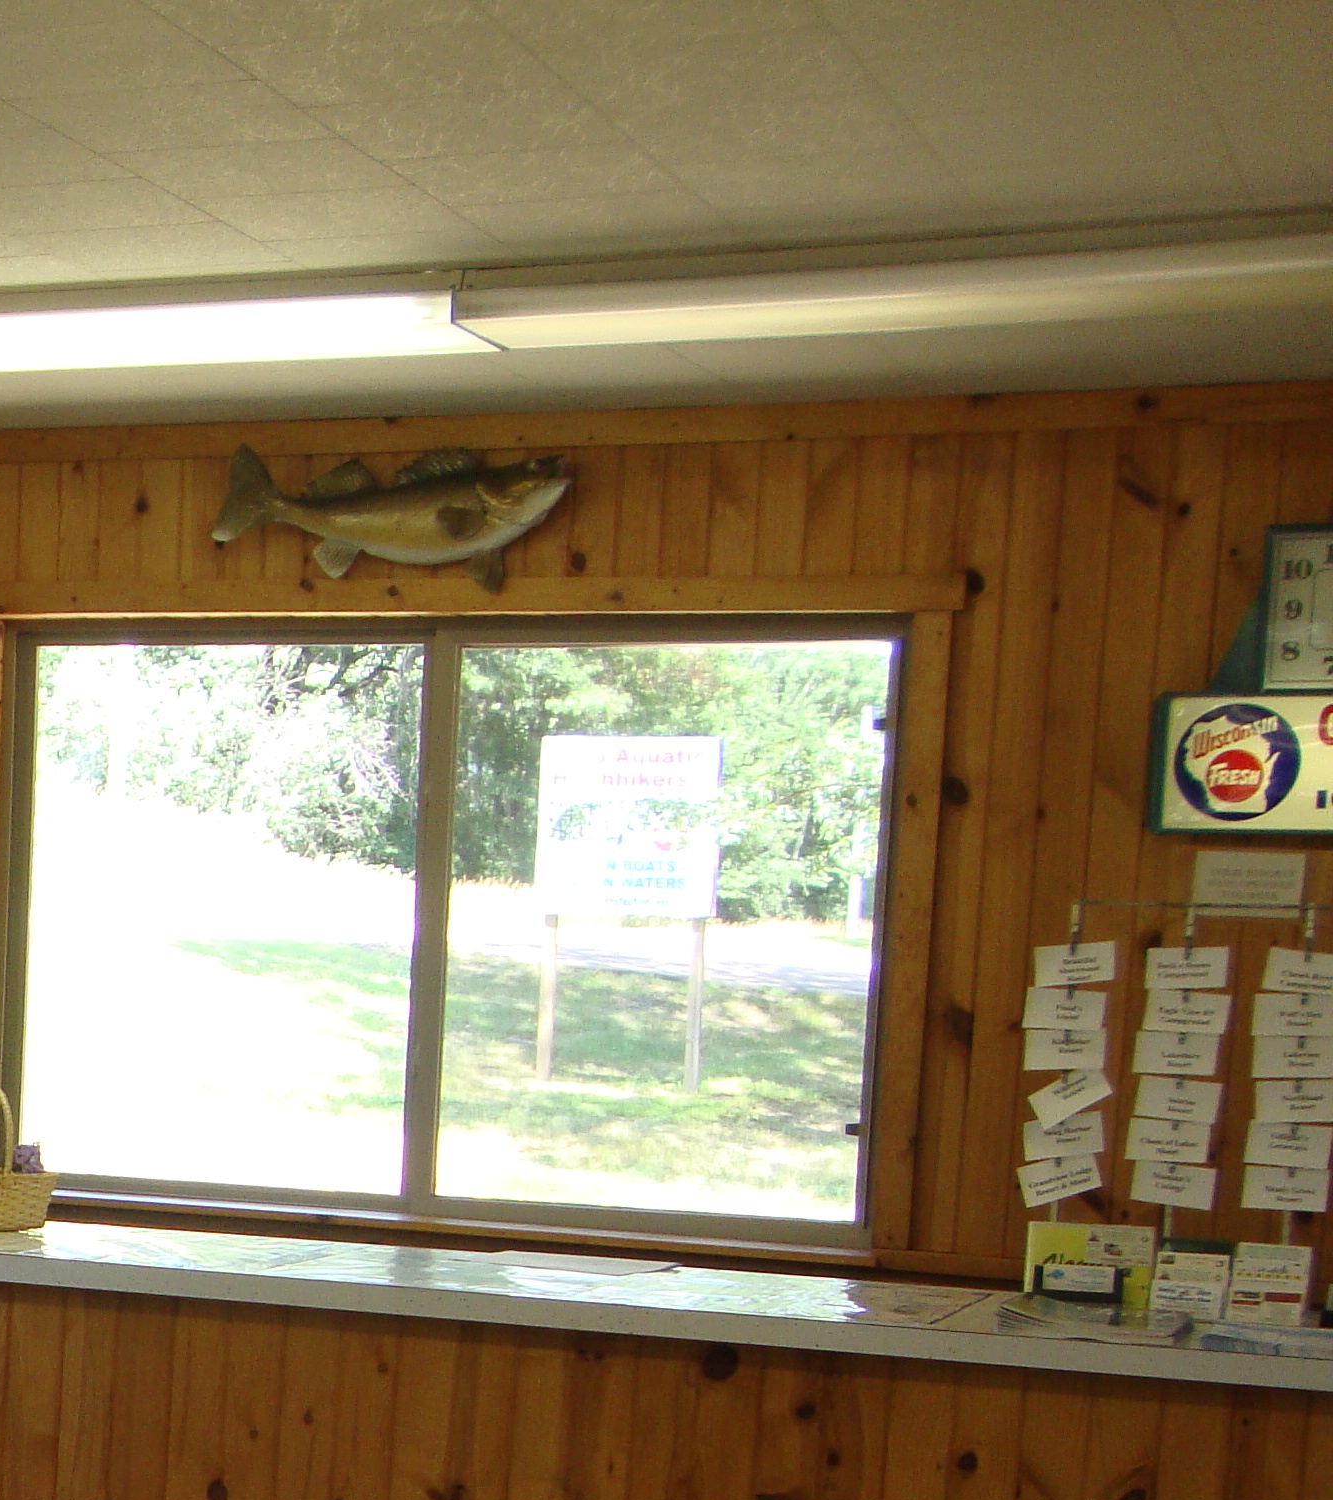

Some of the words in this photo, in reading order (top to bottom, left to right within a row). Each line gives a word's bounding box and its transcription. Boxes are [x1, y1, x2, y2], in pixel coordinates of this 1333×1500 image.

[1283, 559, 1313, 580] 10
[1192, 716, 1278, 759] Wisconsin
[1207, 762, 1261, 787] FRESH
[623, 860, 676, 873] BOATS
[621, 877, 686, 889] WATERS
